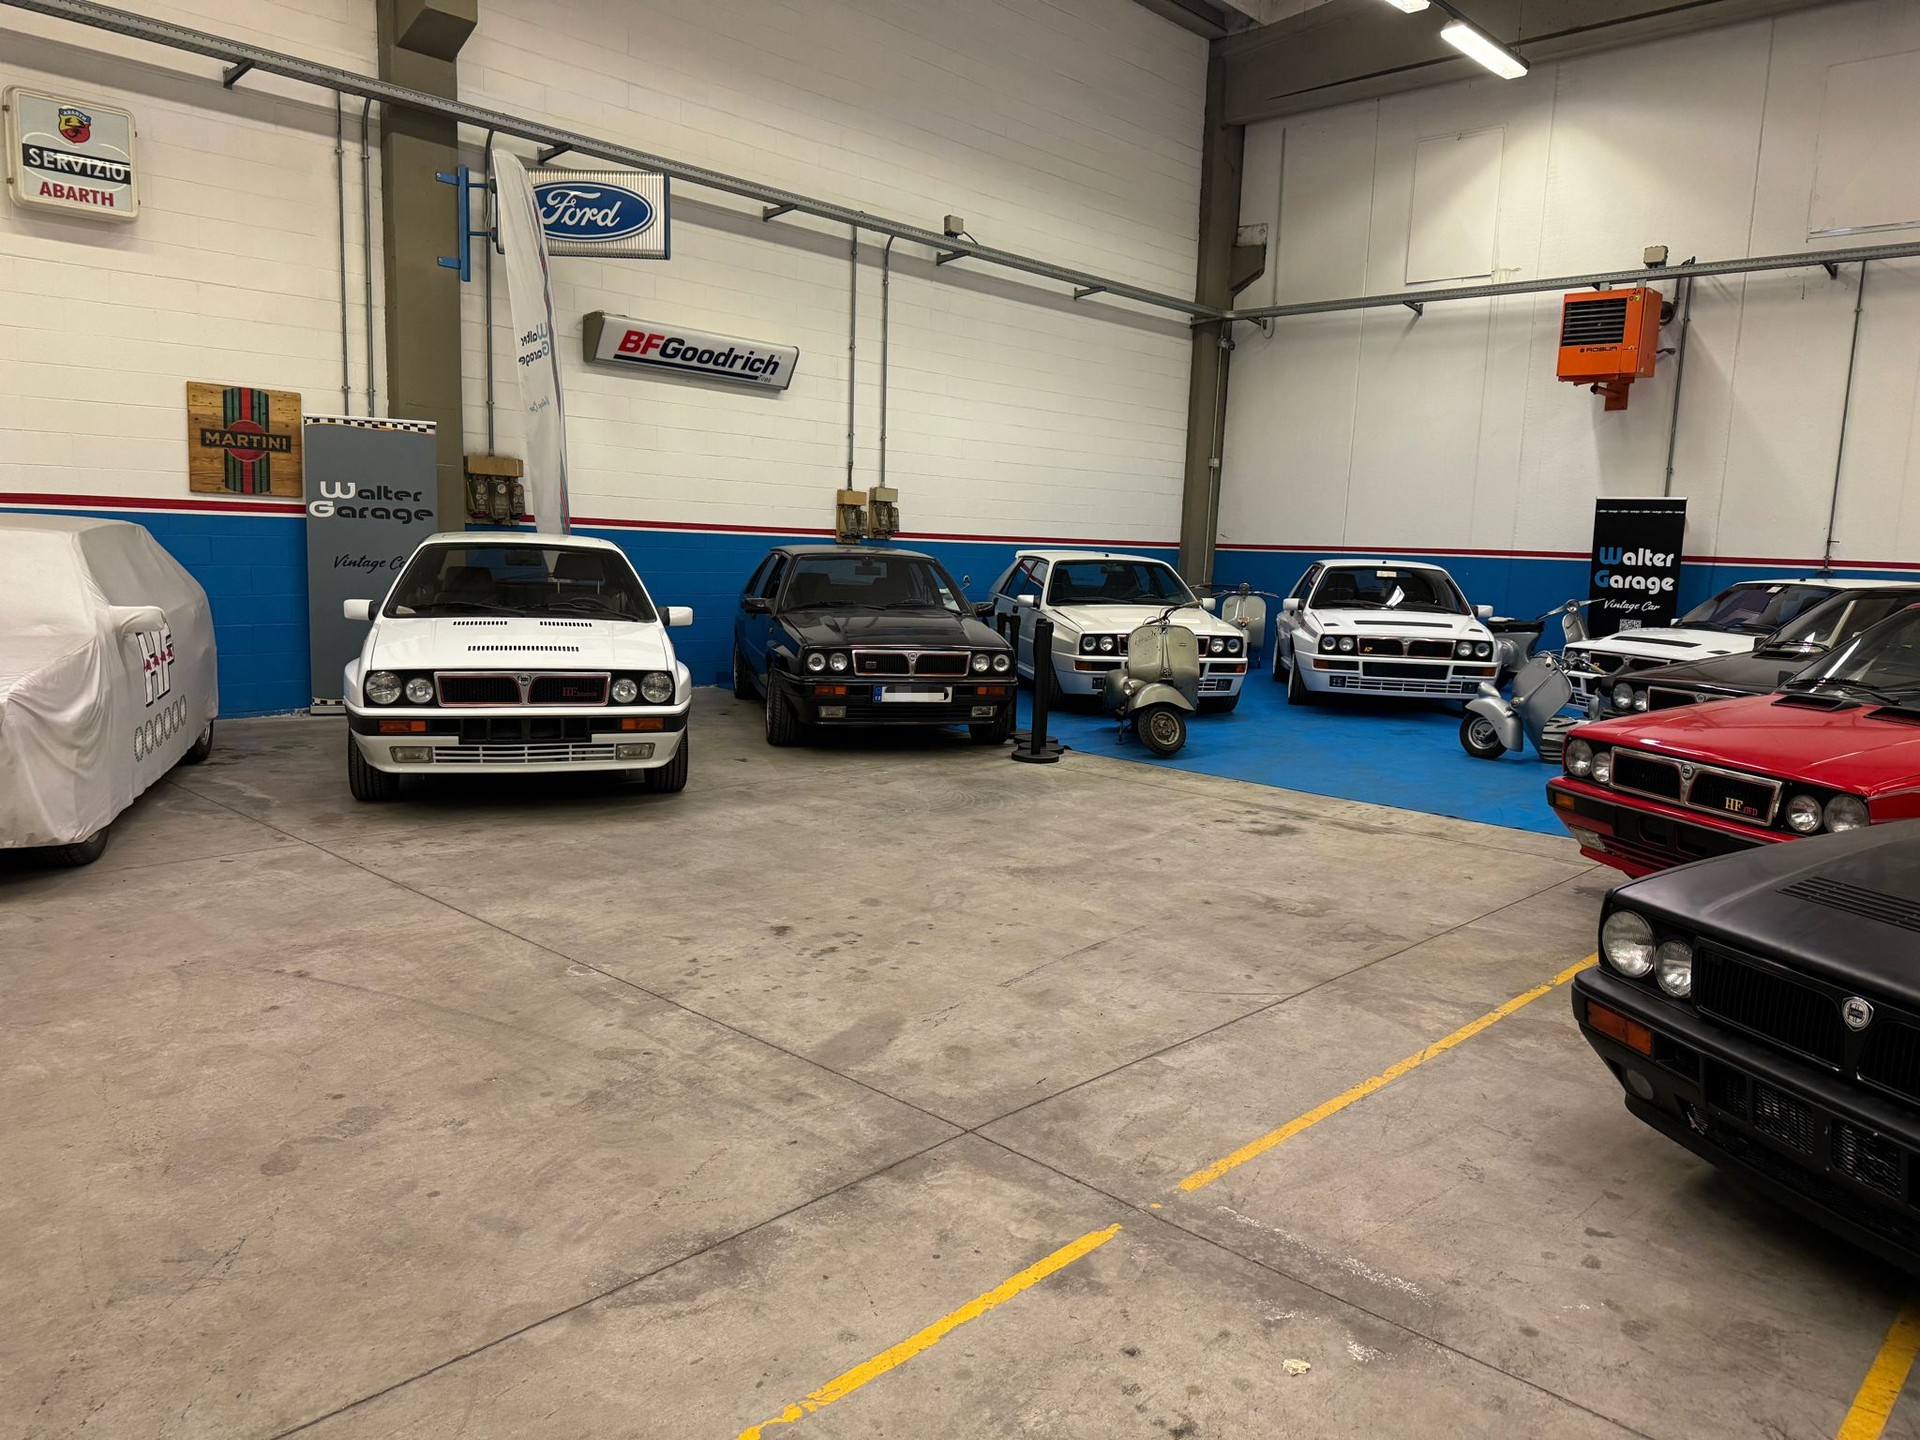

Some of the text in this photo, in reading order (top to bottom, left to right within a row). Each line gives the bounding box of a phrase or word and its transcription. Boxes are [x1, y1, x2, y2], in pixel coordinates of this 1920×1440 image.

[29, 147, 126, 181] SERVIZIO
[39, 181, 114, 207] ABARTH
[540, 189, 622, 227] Ford
[617, 329, 780, 376] BFGoodrich
[204, 430, 288, 451] MARTINI
[320, 480, 423, 503] Walter
[309, 499, 434, 525] Garage
[333, 553, 408, 575] Vintage Ca
[1600, 546, 1675, 568] Walter
[1594, 569, 1675, 595] Garage
[1603, 598, 1661, 614] Vintage Car
[1725, 796, 1744, 812] HF
